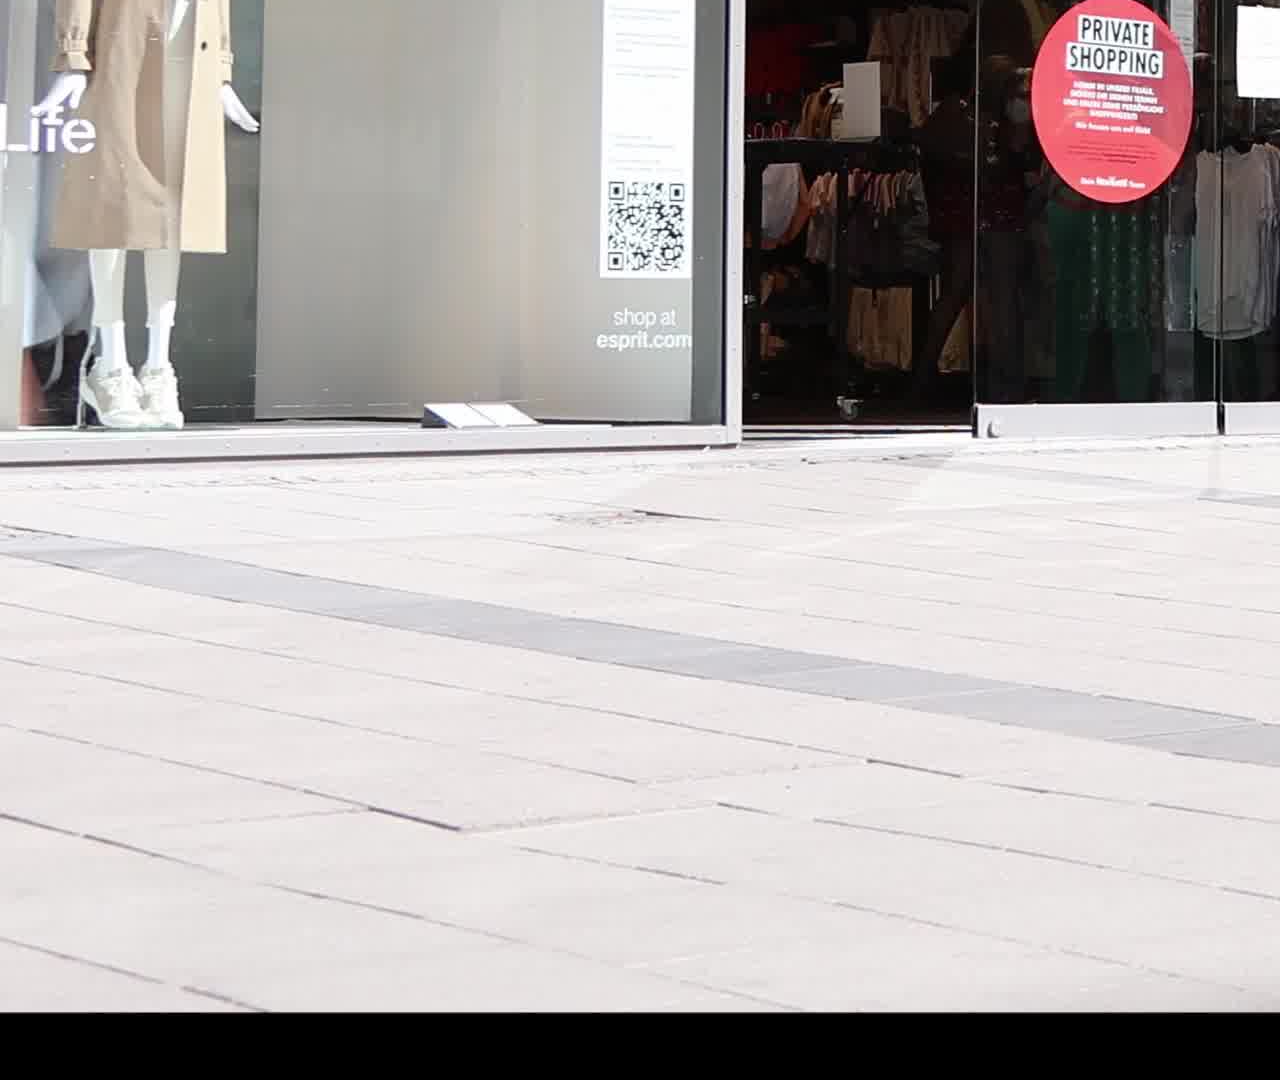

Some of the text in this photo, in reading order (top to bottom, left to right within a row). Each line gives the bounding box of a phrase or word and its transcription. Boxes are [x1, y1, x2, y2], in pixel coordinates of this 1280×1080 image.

[1081, 17, 1150, 46] PRIVATE
[1069, 45, 1160, 75] SHOPPING
[613, 307, 676, 329] shop at
[596, 330, 692, 352] esprit.com
